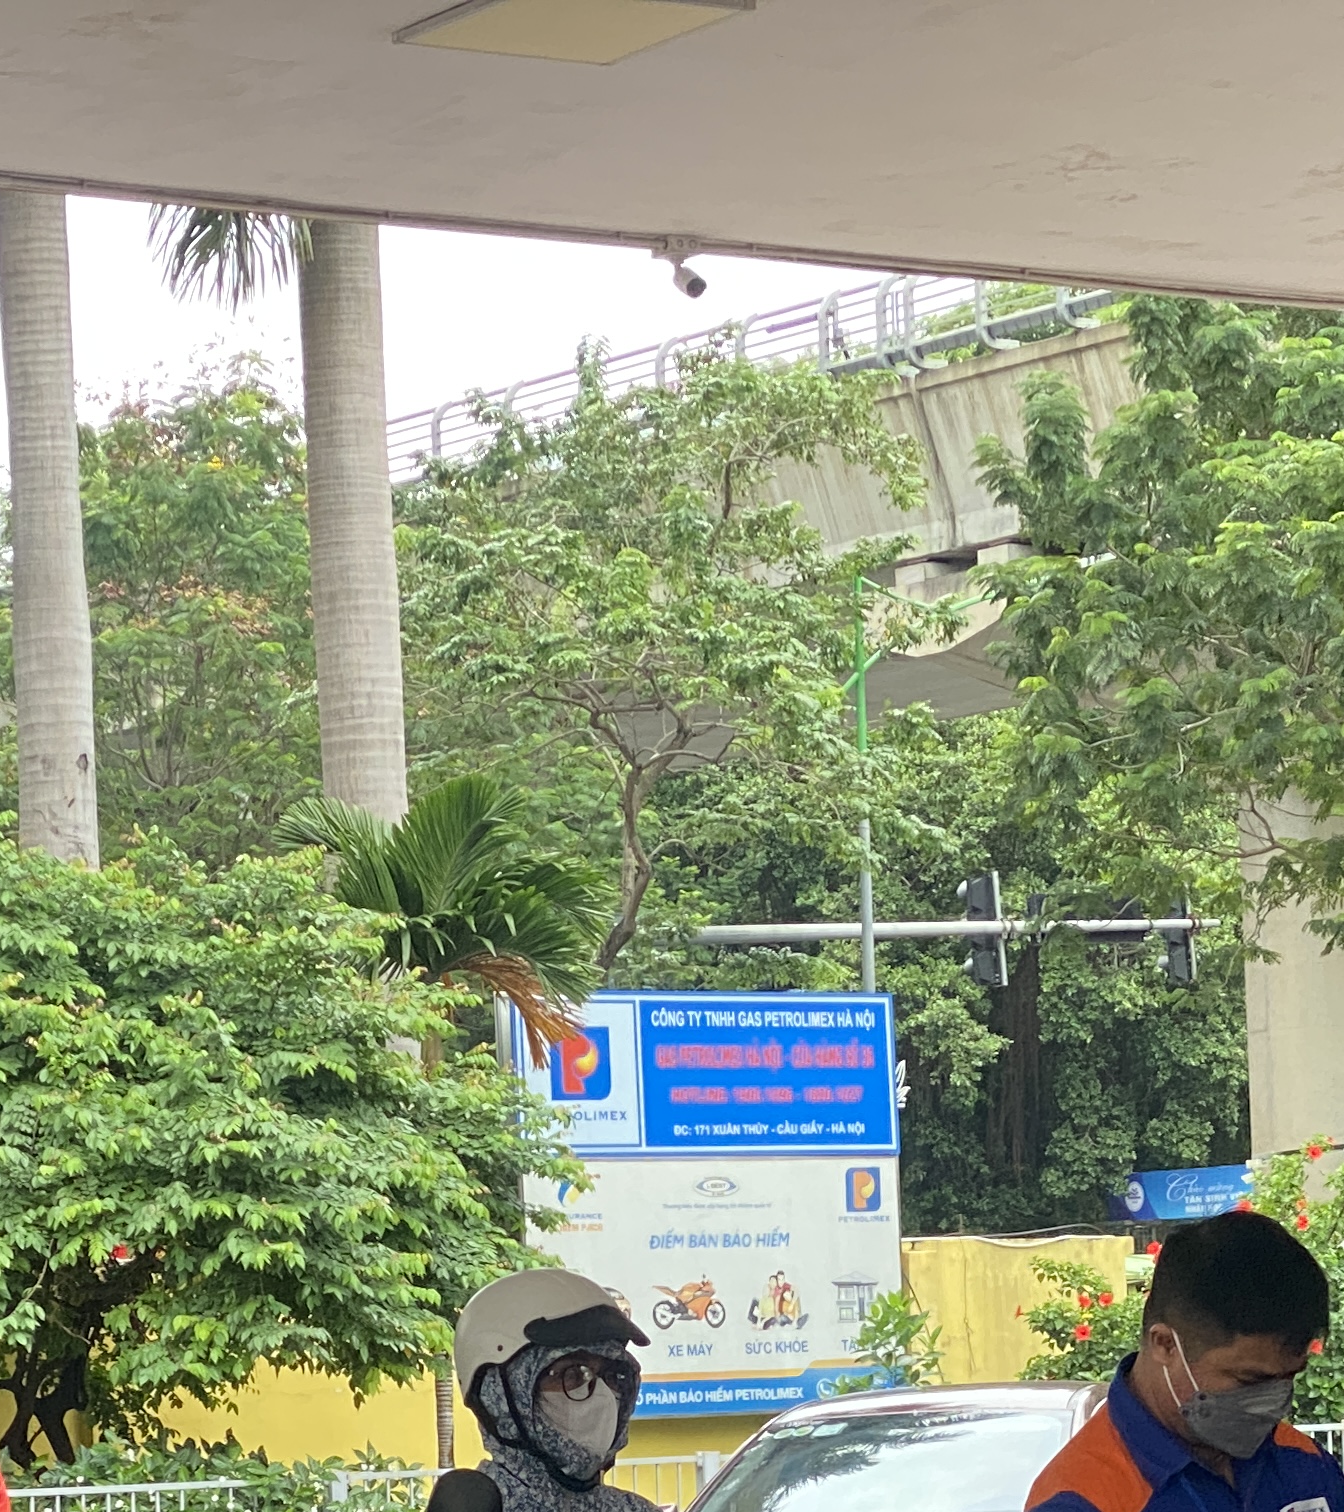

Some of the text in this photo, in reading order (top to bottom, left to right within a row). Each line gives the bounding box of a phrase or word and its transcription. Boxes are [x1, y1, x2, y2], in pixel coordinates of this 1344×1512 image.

[651, 1007, 875, 1031] CÔNG TY TNHH GAS PETROLIMEX HÀ NỘI
[673, 1125, 693, 1137] ĐC:
[694, 1125, 710, 1136] 171
[712, 1122, 741, 1136] XUÂN
[777, 1119, 798, 1136] CẦU
[800, 1120, 824, 1136] GIẤY
[831, 1121, 846, 1135] HÀ
[847, 1121, 865, 1137] NỘI
[838, 1215, 890, 1223] PETROLIMEX
[650, 1226, 790, 1249] ĐIỂM BÁN BẢO HIỂM
[668, 1342, 713, 1357] XE MÁY
[745, 1339, 808, 1354] SỨC KHỎE
[646, 1385, 803, 1405] PHẦN BẢO HIỂM PETROLIMEX
